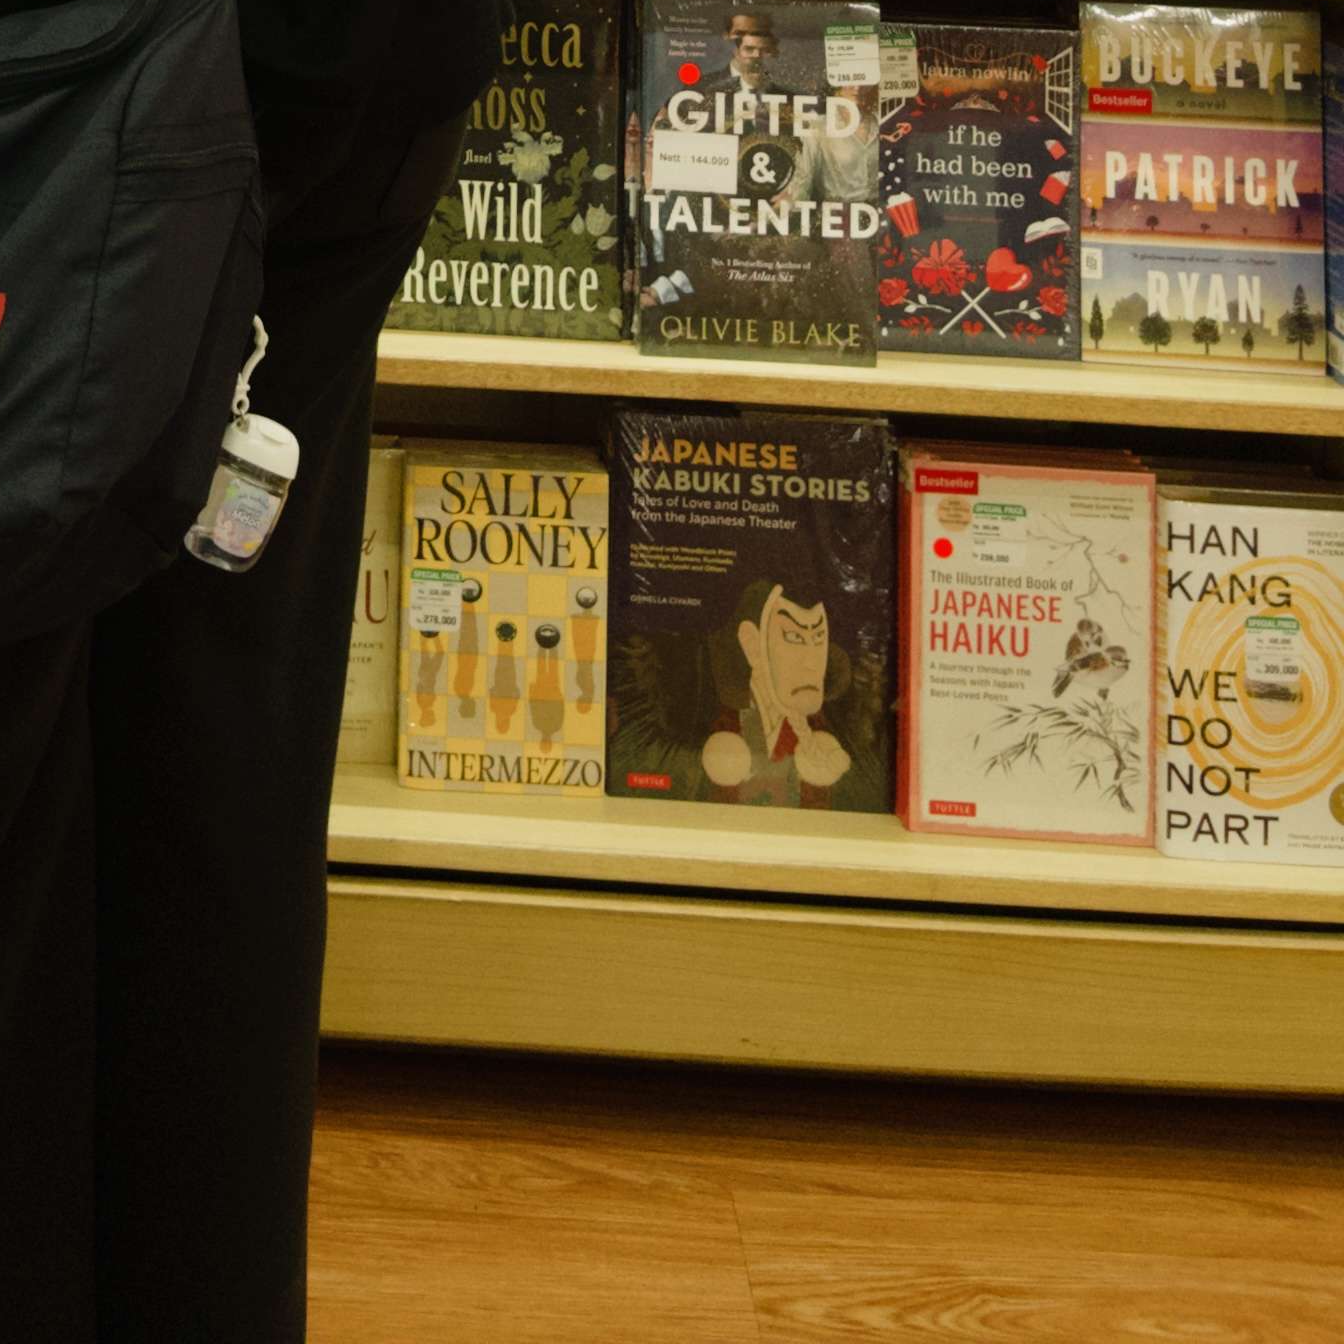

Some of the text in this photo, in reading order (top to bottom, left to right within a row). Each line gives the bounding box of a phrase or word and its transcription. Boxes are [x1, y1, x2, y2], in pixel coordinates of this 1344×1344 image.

[667, 90, 862, 138] GIFTED
[947, 125, 1003, 146] if he
[916, 153, 1033, 179] had been
[1105, 150, 1300, 208] PATRICK
[458, 180, 544, 244] Wild
[643, 194, 880, 239] TALENTED
[923, 185, 1026, 209] with me
[401, 246, 600, 313] Reverence
[1146, 268, 1262, 324] RYAN
[659, 315, 862, 347] OLIVIE BLAKE
[633, 437, 798, 471] JAPANESE
[440, 470, 586, 520] SALLY
[632, 469, 871, 504] KABUKI STORIES
[632, 493, 782, 514] Tales of Love and Death
[413, 516, 607, 571] ROONEY
[1167, 520, 1259, 559] HAN
[929, 588, 1063, 624] JAPANESE
[1166, 568, 1293, 609] KANG
[928, 619, 1032, 659] HAIKU
[1167, 666, 1238, 704] WE
[406, 748, 604, 789] INTERMEZZO
[1165, 809, 1280, 848] PART
